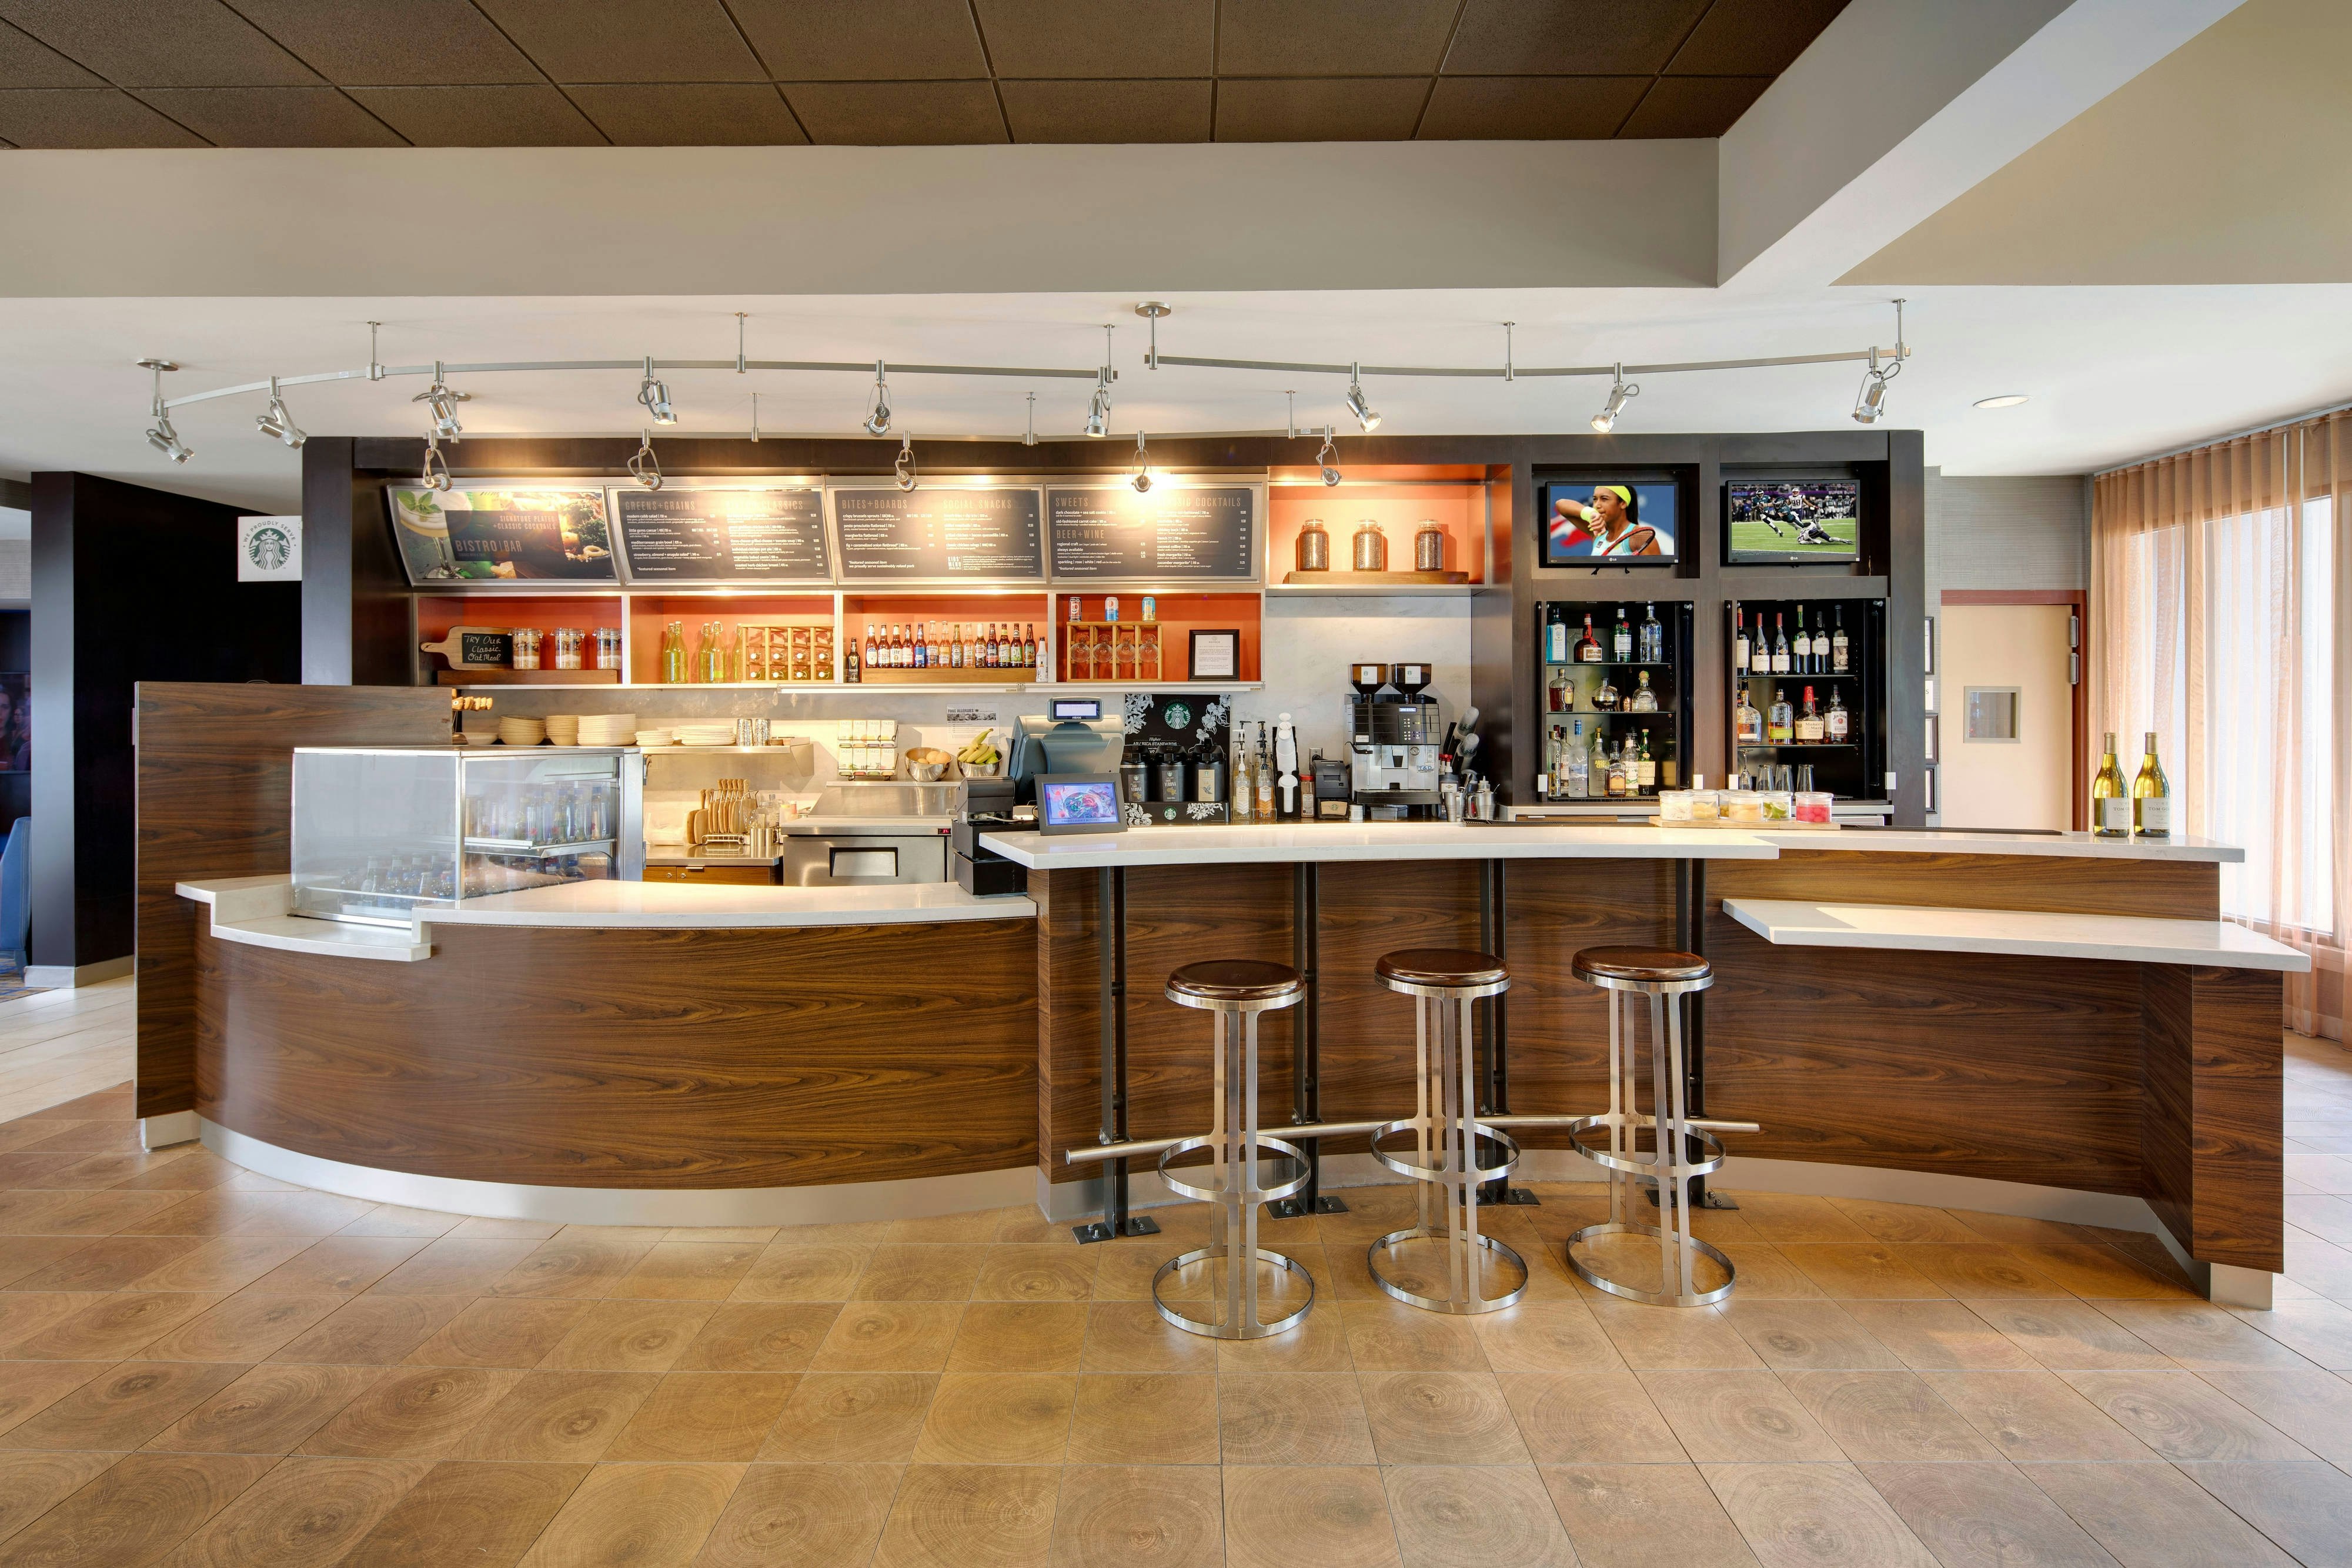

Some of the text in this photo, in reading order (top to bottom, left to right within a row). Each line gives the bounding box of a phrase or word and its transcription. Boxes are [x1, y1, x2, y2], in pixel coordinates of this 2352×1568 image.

[625, 501, 696, 510] GREENS+GRAINS
[761, 500, 804, 510] CLASSICS
[841, 500, 908, 509] BITES+BOARDS
[942, 499, 1012, 509] SOCIAL SNACKS
[1055, 497, 1089, 507] SWEETS
[1195, 497, 1241, 507] COCKTAILS
[243, 520, 296, 542] WE PROUDLY SERVE
[1056, 530, 1105, 539] BEER+WINE
[455, 540, 523, 553] BISTRO BAR
[463, 635, 480, 644] TRY
